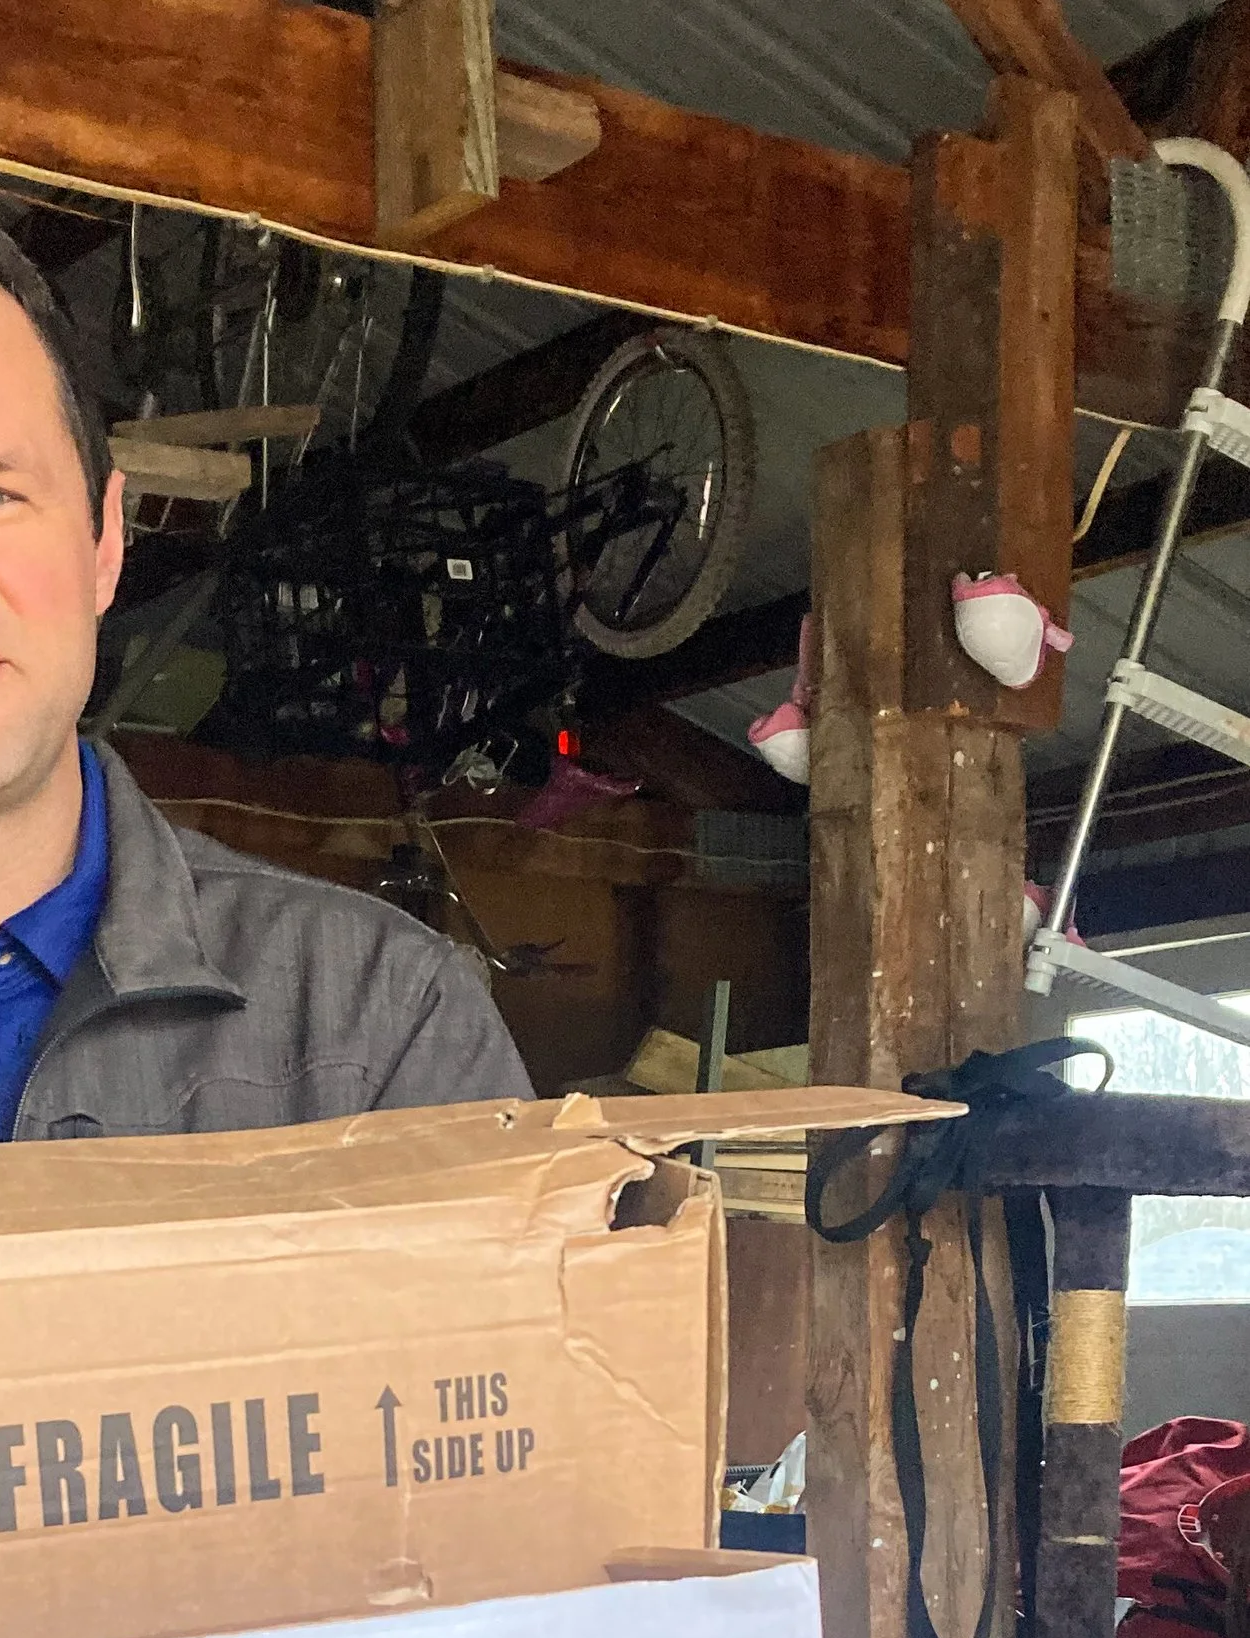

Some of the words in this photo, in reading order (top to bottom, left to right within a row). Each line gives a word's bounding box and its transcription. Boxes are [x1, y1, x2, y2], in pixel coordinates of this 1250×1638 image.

[434, 1372, 508, 1422] THIS
[414, 1434, 483, 1482] SIDE
[496, 1427, 535, 1473] UP
